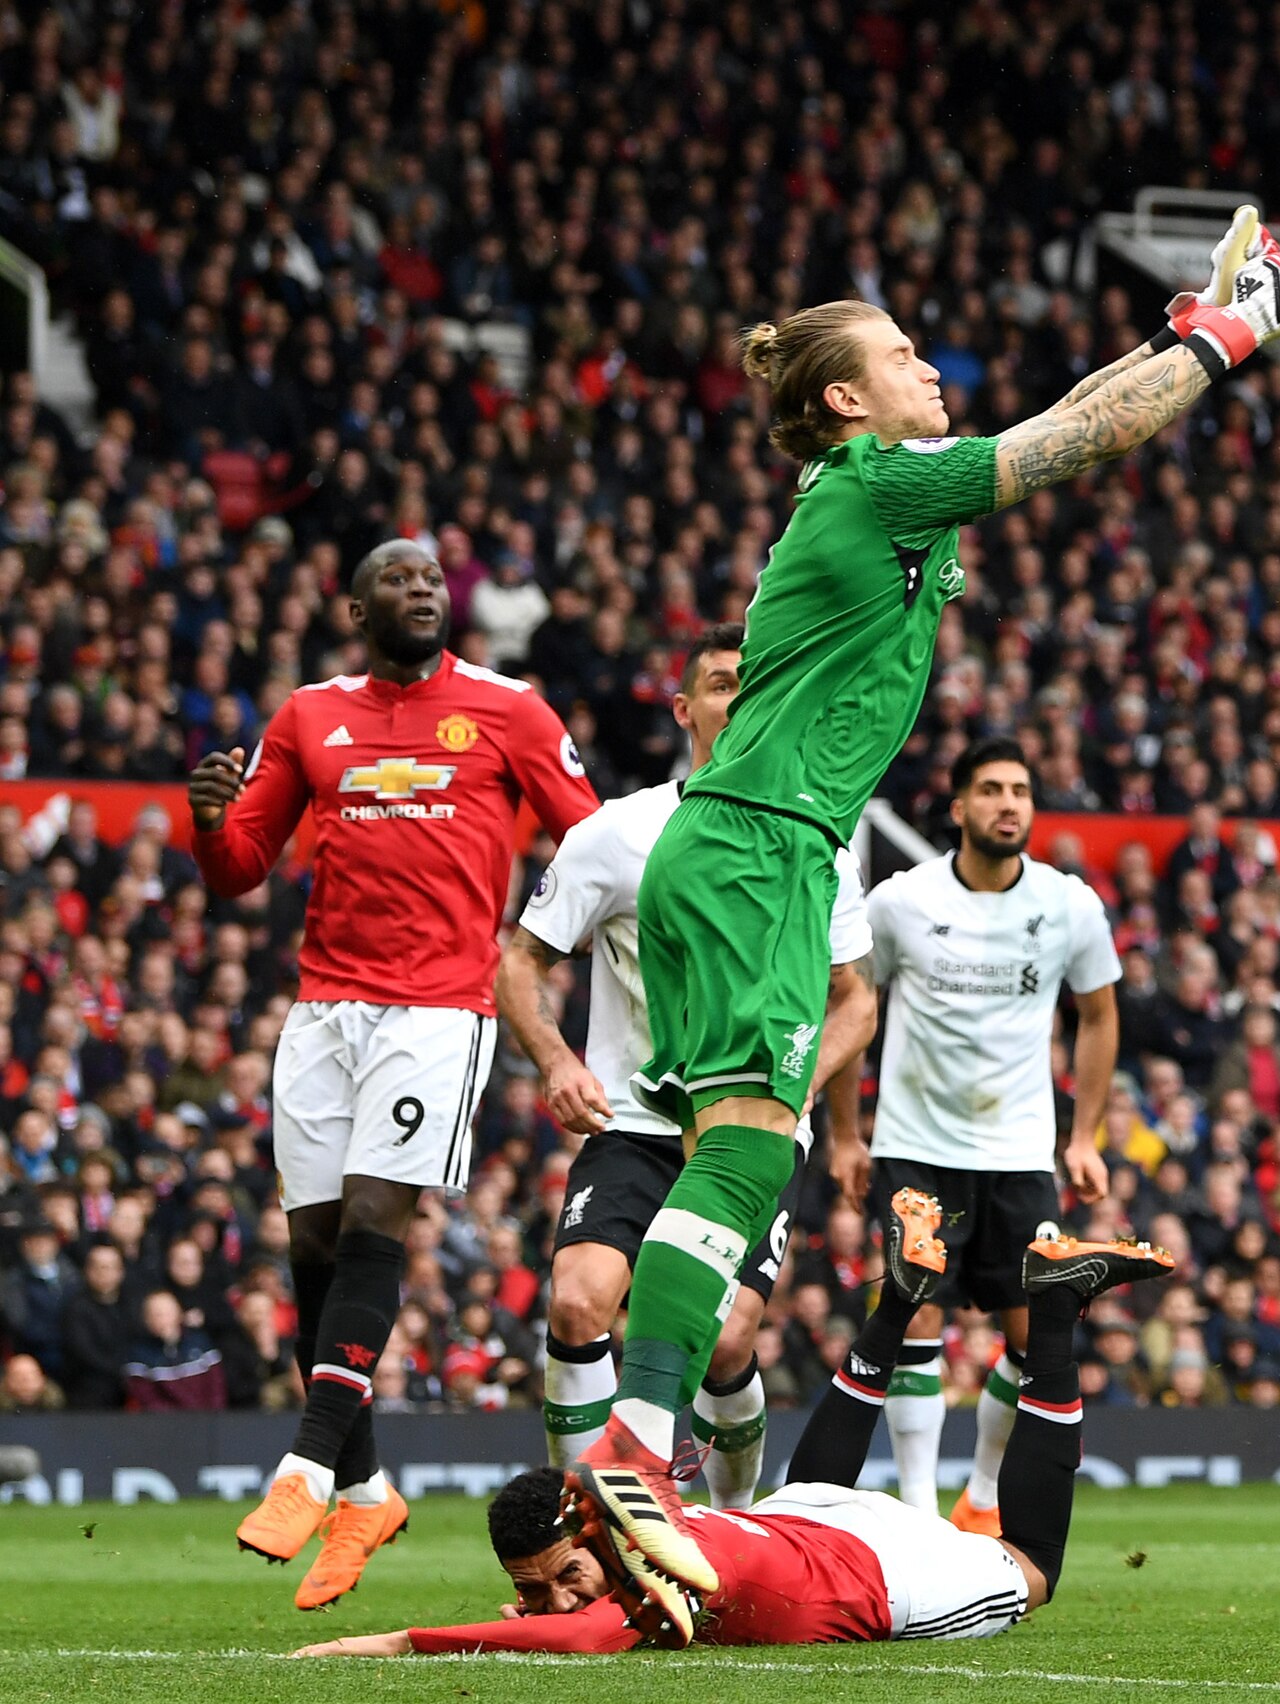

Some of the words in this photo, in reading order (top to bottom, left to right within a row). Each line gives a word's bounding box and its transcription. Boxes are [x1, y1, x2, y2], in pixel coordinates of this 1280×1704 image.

[340, 803, 457, 821] CHEVROLET
[934, 958, 1014, 977] Standard
[926, 975, 1013, 996] Chartered
[391, 1096, 425, 1148] 9
[770, 1209, 790, 1263] 6
